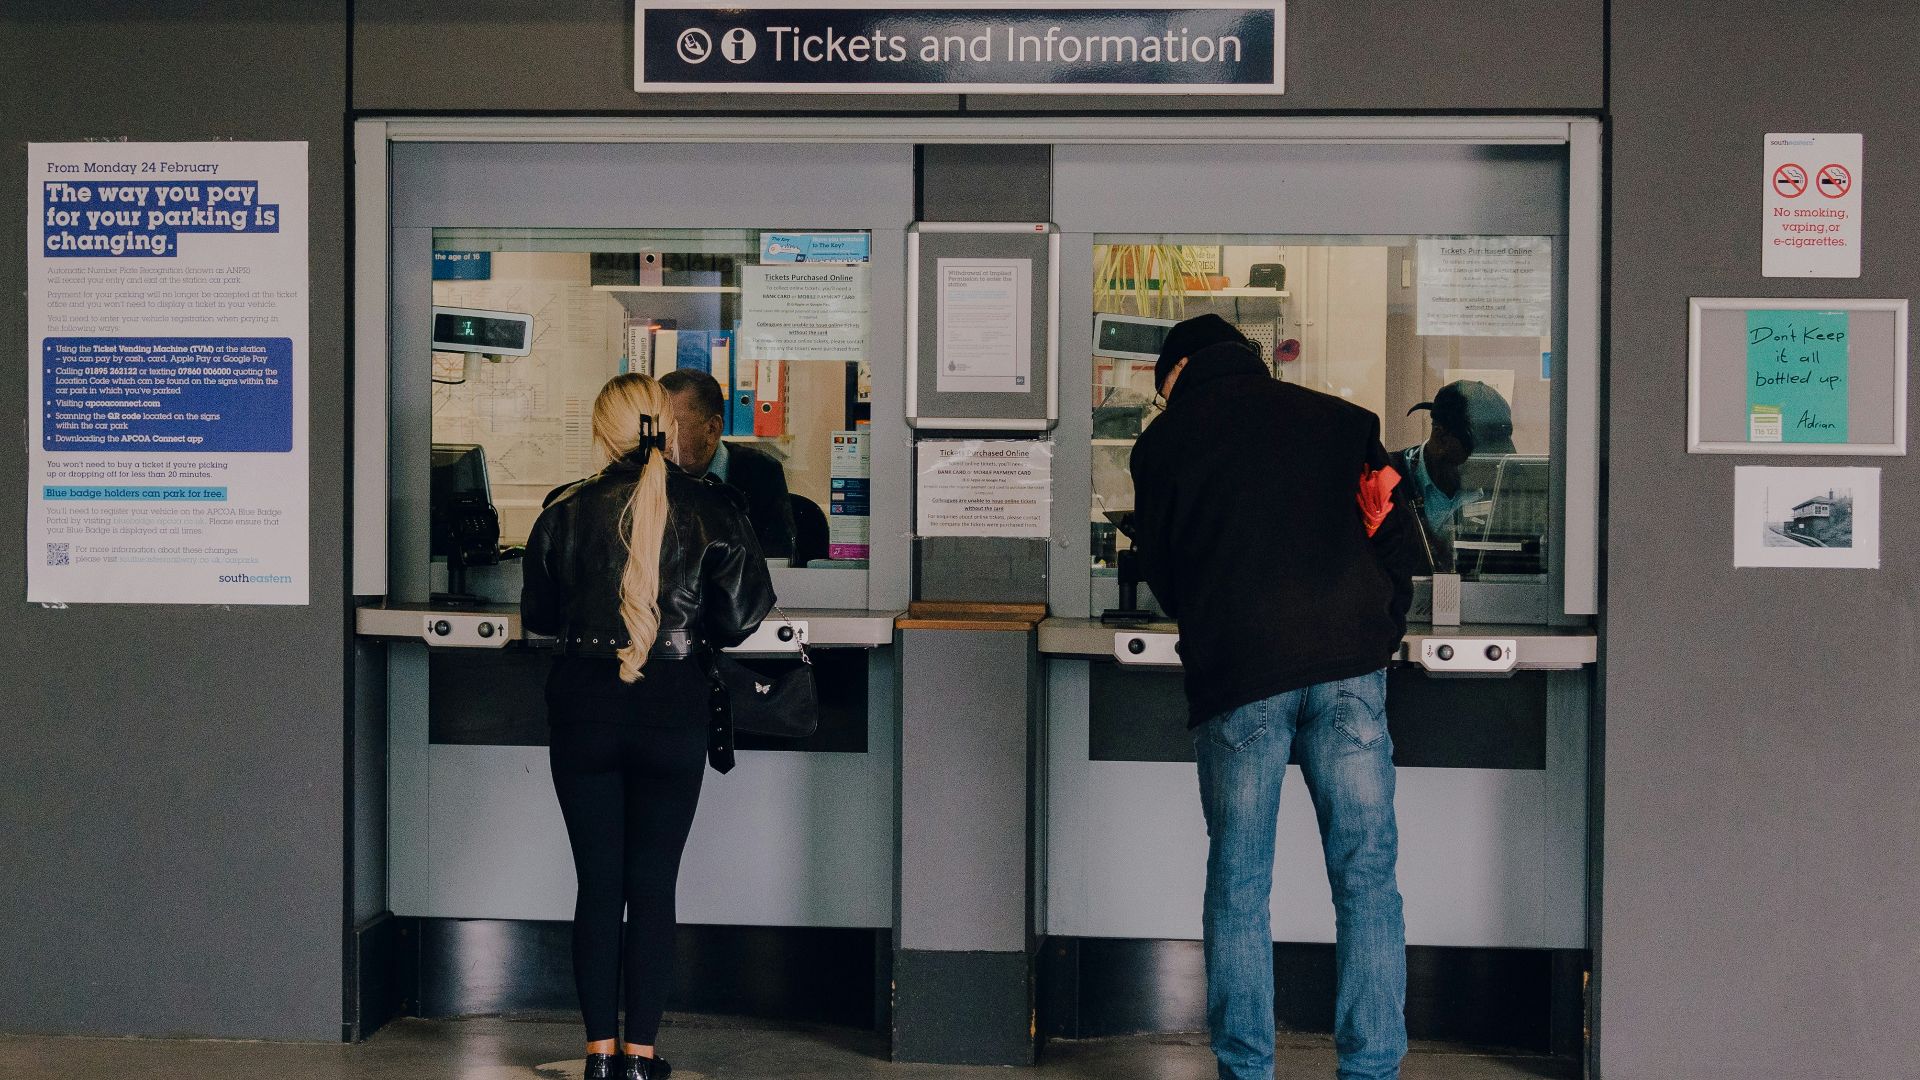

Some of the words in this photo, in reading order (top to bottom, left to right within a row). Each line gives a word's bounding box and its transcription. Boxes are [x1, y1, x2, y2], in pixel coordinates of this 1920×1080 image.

[766, 26, 907, 63] Tickets
[920, 27, 990, 63] and
[1006, 27, 1242, 63] Information
[48, 162, 79, 172] From
[84, 162, 136, 174] Monday
[142, 162, 155, 172] 24
[161, 162, 218, 174] February
[46, 183, 91, 202] The
[98, 186, 149, 206] way
[155, 186, 200, 206] you
[207, 186, 255, 206] pay
[47, 206, 80, 226] for
[86, 209, 141, 230] your
[148, 206, 248, 230] parking
[255, 206, 275, 226] is
[1774, 208, 1790, 217] No
[1794, 208, 1848, 220] smoking,
[46, 231, 174, 255] changing.
[1774, 236, 1847, 248] e-cigarettes.
[1750, 323, 1796, 345] Don't
[56, 345, 77, 354] Using
[79, 345, 91, 353] the
[93, 345, 117, 353] Ticket
[119, 345, 152, 354] Vending
[153, 345, 188, 353] Machine
[190, 345, 214, 354] (TVM)
[215, 345, 224, 353] at
[226, 345, 238, 353] the
[240, 345, 266, 353] station
[113, 355, 123, 364] by
[170, 355, 194, 364] Apple
[196, 355, 211, 364] Pay
[222, 355, 251, 364] Google
[252, 355, 268, 364] Pay
[1776, 348, 1788, 363] it
[1800, 350, 1819, 363] all
[56, 367, 83, 377] Calling
[149, 367, 176, 377] texting
[232, 367, 263, 377] quoting
[218, 377, 238, 386] signs
[1756, 370, 1812, 387] bottled
[1820, 375, 1842, 390] up.
[70, 387, 87, 396] park
[125, 387, 151, 396] you've
[152, 387, 181, 396] parked
[56, 400, 83, 409] Visiting
[85, 400, 161, 409] apcoaconnect.com
[56, 412, 91, 422] Scanning
[200, 412, 220, 422] signs
[1797, 410, 1835, 428] Adrian
[110, 422, 128, 431] park
[56, 435, 105, 444] Downloading
[47, 460, 60, 469] You
[63, 460, 83, 469] won't
[86, 460, 105, 469] need
[107, 460, 114, 469] to
[117, 460, 132, 470] buy
[142, 460, 164, 469] ticket
[166, 460, 171, 469] if
[173, 460, 196, 470] you're
[198, 460, 228, 470] picking
[69, 470, 105, 480] dropping
[107, 470, 117, 478] off
[119, 470, 129, 478] for
[132, 470, 146, 478] less
[148, 470, 166, 478] than
[168, 470, 178, 478] 20
[179, 470, 212, 478] minutes.
[46, 488, 67, 498] Blue
[70, 488, 101, 499] badge
[104, 488, 140, 498] holders
[163, 488, 185, 499] park
[188, 488, 200, 498] for
[204, 488, 224, 498] free.
[218, 573, 292, 583] southeastern
